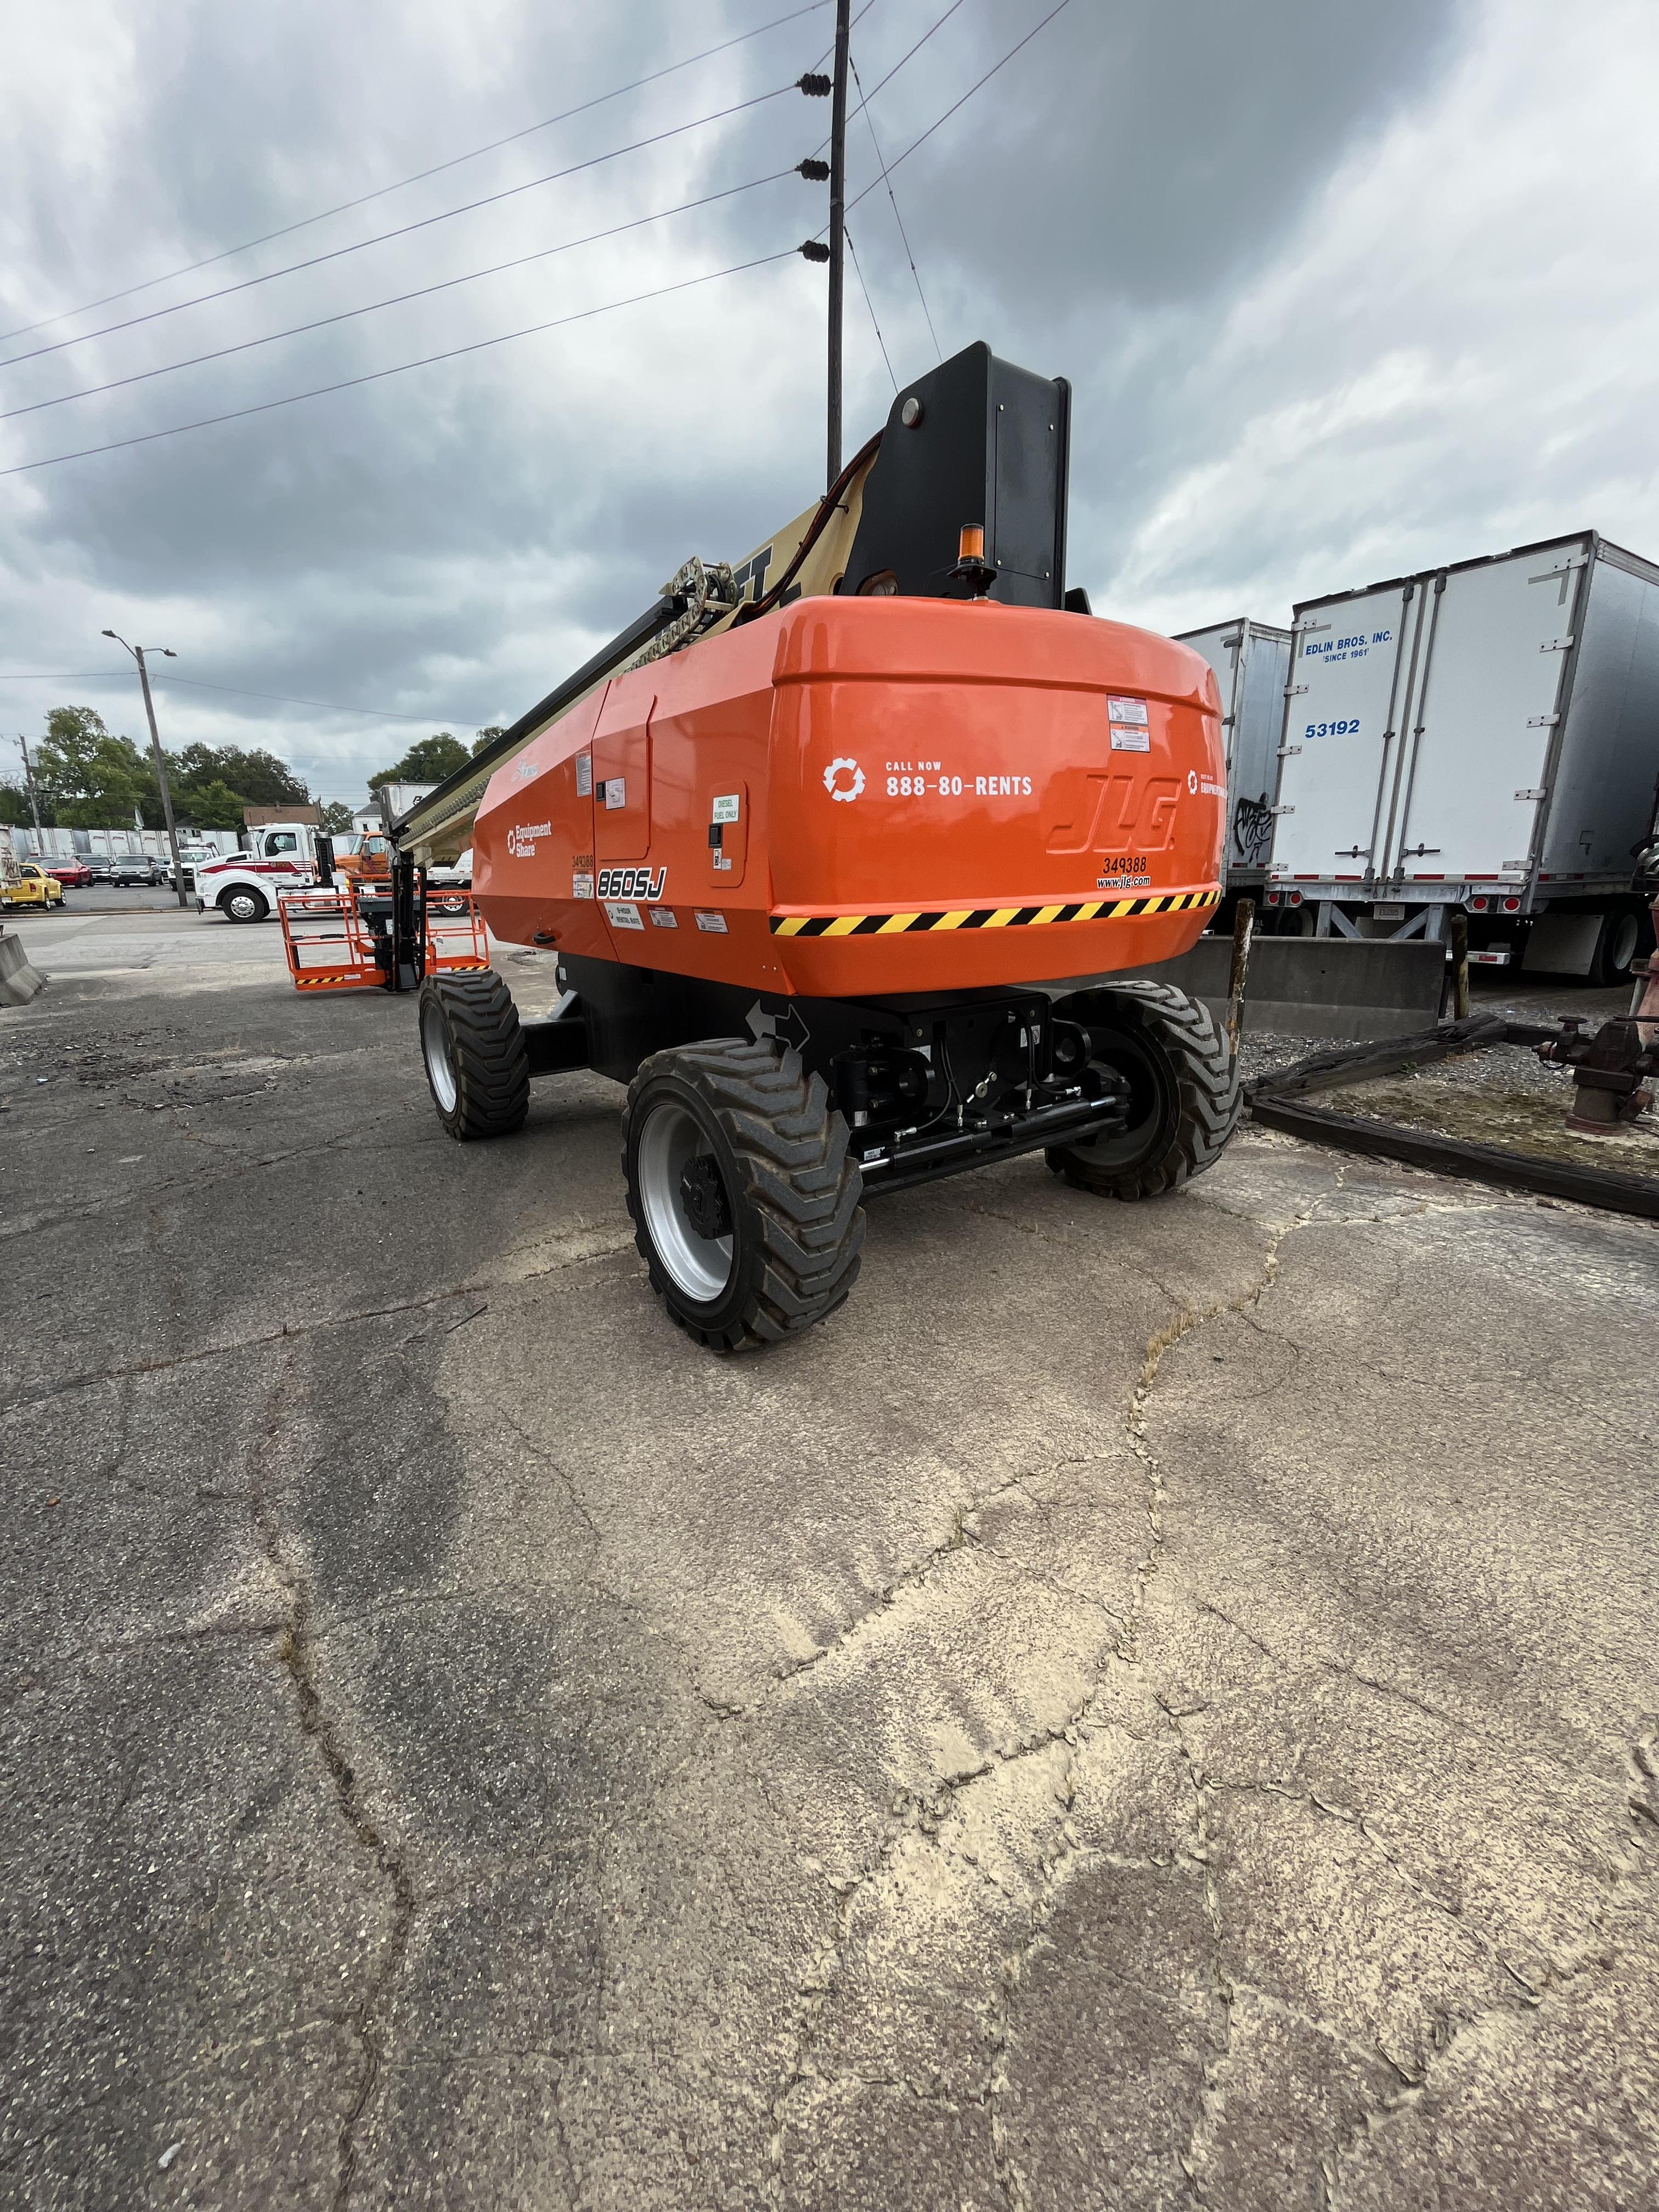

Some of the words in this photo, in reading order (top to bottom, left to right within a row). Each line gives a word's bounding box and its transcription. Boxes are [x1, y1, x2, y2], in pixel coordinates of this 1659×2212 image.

[1306, 641, 1334, 655] EDLIN
[1337, 635, 1368, 650] BROS.
[1372, 630, 1392, 644] INC.
[1305, 719, 1360, 738] 53192
[885, 761, 913, 771] CALL
[917, 761, 941, 771] NOW
[886, 776, 1032, 796] 888-80-RENTS
[719, 799, 733, 808] DIESEL
[725, 810, 737, 819] ONLY
[516, 820, 552, 842] Equipment
[516, 843, 536, 857] Share
[1103, 856, 1147, 874] 349388
[597, 867, 667, 901] 860SJ
[1097, 876, 1150, 889] www.jlg.com
